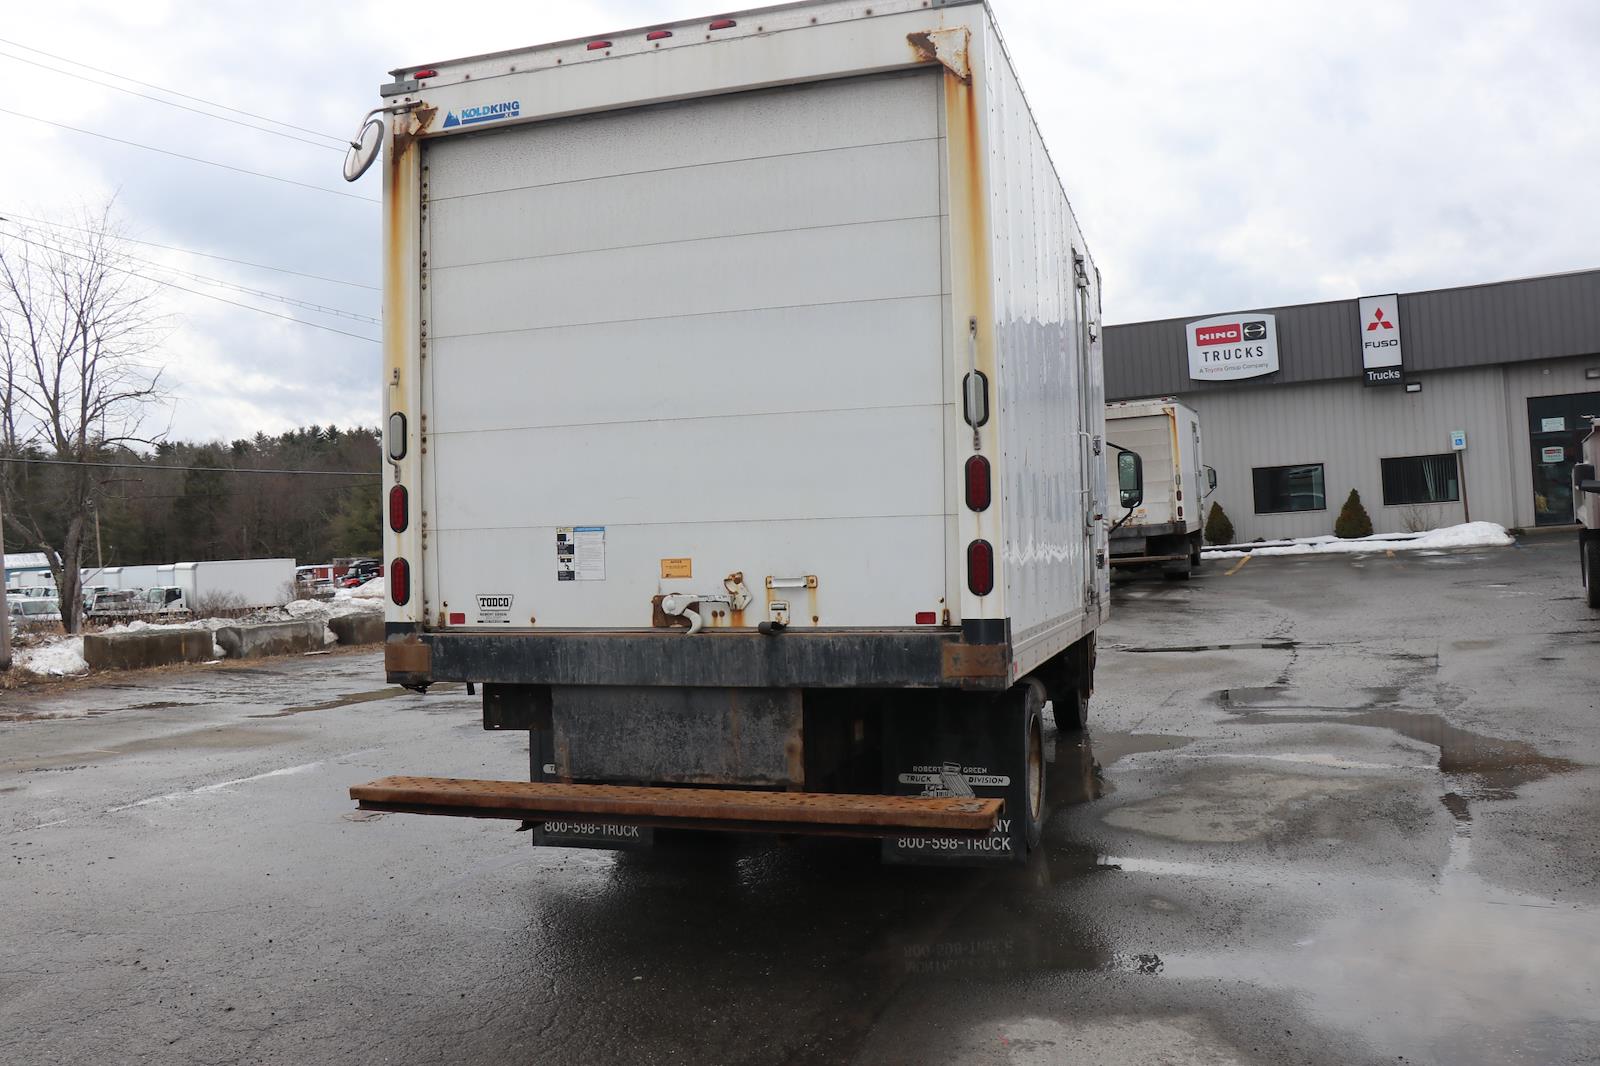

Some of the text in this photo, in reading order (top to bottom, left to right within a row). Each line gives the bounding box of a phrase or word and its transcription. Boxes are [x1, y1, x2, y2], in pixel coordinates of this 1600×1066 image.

[461, 101, 520, 119] KOLDKING
[1199, 330, 1238, 341] HINO
[1364, 339, 1399, 349] FUSO
[1202, 346, 1264, 362] TRUCKS
[1367, 370, 1401, 381] Trucks
[480, 597, 509, 607] TODCO
[912, 765, 988, 774] ROBERT GREEN
[906, 775, 1004, 784] TRUCK DIVISION
[544, 821, 640, 837] 800-598-TRUCK
[898, 837, 1011, 851] 800-598-TRUCK
